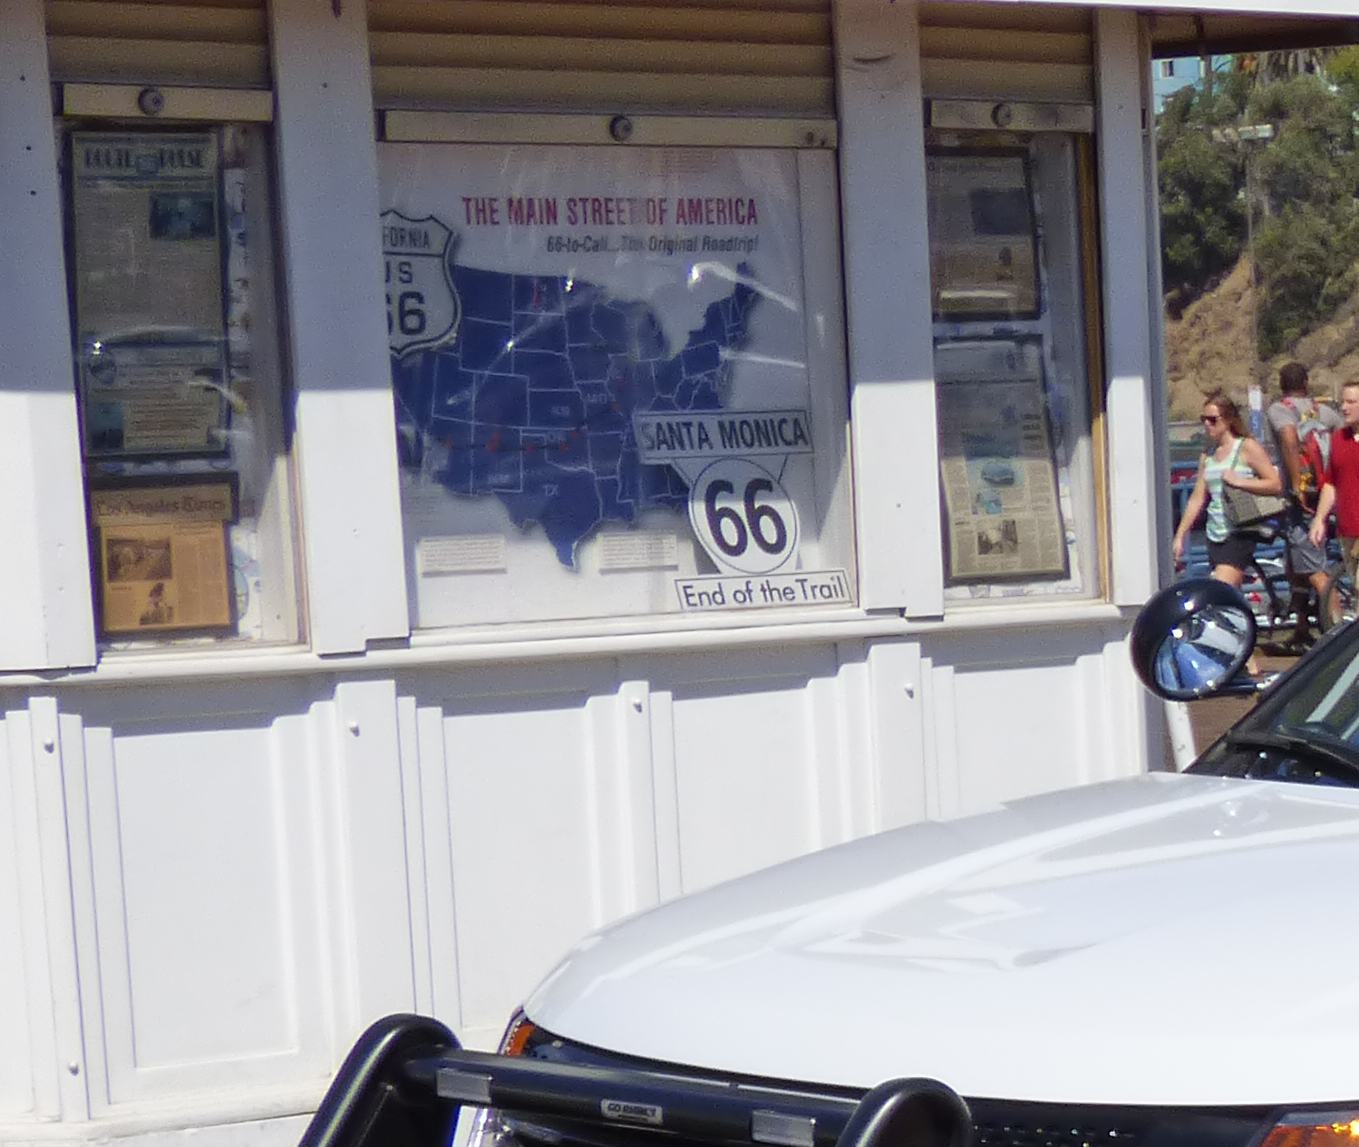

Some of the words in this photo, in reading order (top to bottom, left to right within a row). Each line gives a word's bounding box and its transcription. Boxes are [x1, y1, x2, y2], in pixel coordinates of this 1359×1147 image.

[462, 197, 500, 225] THE
[508, 197, 558, 225] MAIN
[567, 197, 638, 226] STREET
[646, 197, 669, 225] OF
[676, 197, 758, 226] AMERICA
[648, 234, 698, 256] Original
[386, 291, 426, 336] 6
[641, 420, 710, 450] SANTA
[719, 416, 810, 448] MONICA
[704, 478, 787, 557] 66
[682, 580, 726, 607] End
[733, 577, 759, 604] of
[759, 578, 796, 603] the
[796, 575, 845, 600] Trail
